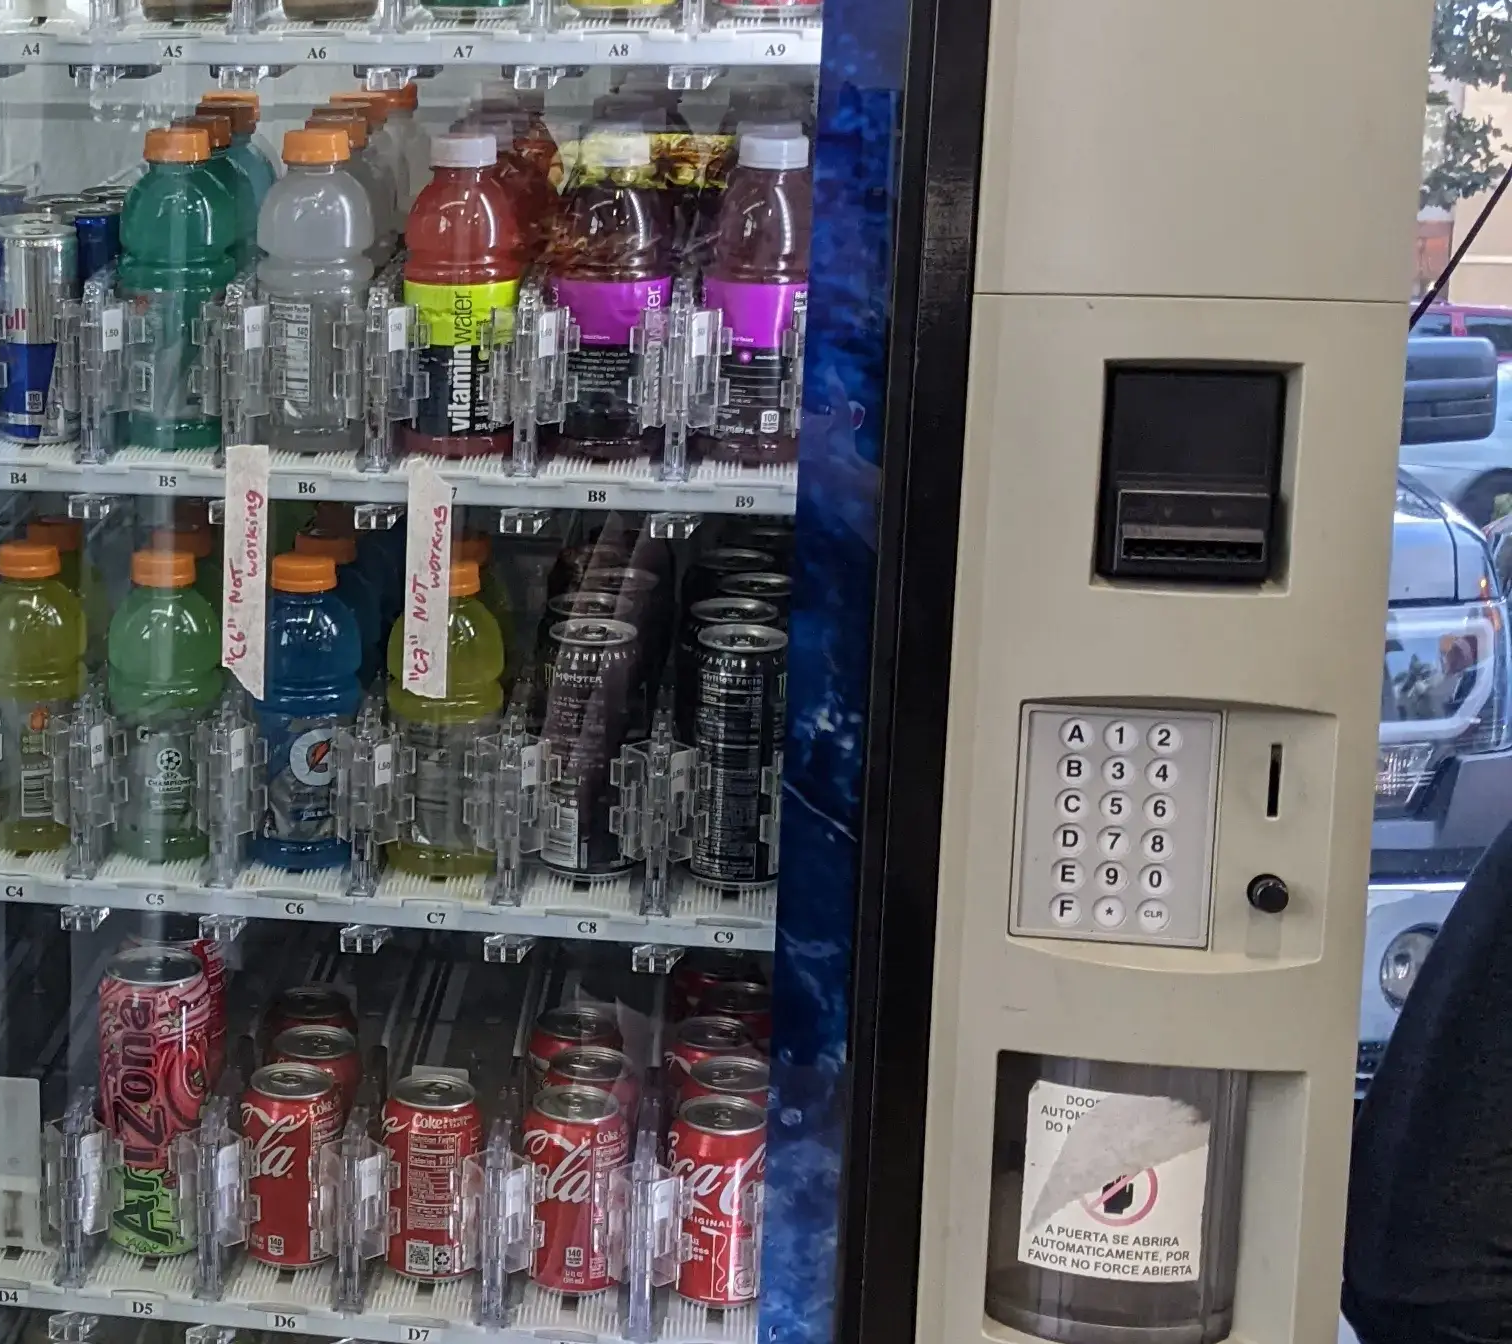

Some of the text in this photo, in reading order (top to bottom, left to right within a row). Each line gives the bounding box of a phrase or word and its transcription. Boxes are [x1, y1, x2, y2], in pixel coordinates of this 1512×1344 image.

[22, 43, 40, 56] A4
[163, 44, 182, 58] A5
[307, 47, 327, 60] A6
[453, 45, 474, 59] A7
[608, 43, 629, 57] A8
[764, 43, 786, 57] A9
[6, 308, 26, 330] ull
[105, 327, 119, 338] 1.50
[763, 413, 778, 422] 100
[10, 471, 28, 484] B4
[159, 475, 177, 488] B5
[298, 481, 316, 494] B6
[587, 489, 607, 503] B8
[734, 495, 755, 509] B9
[229, 558, 244, 604] NOT
[412, 574, 430, 622] NOT
[1067, 726, 1171, 746] A 1 2
[1066, 760, 1169, 782] B 3 4
[1064, 795, 1166, 818] C 5 6
[1062, 831, 1164, 853] D 7 8
[1061, 865, 1162, 889] E 9 0
[5, 885, 24, 898] C4
[146, 893, 164, 906] C5
[285, 902, 304, 915] C6
[1059, 901, 1163, 919] F CLR
[426, 911, 446, 925] C7
[577, 920, 597, 934] C8
[713, 930, 734, 944] C9
[113, 996, 174, 1247] AriZona
[411, 1111, 443, 1131] Coke
[1045, 1120, 1063, 1132] DO
[270, 1236, 283, 1247] 140
[1045, 1223, 1180, 1248] A PUERTA SE ABRIRA
[567, 1249, 581, 1258] 140
[1031, 1235, 1190, 1263] AUTOMATICAMENTE, POR
[1027, 1248, 1192, 1277] FAVOR NO FORCE ABIERTA
[132, 1301, 153, 1315] D5
[274, 1314, 295, 1329] D6
[407, 1327, 430, 1342] D7
